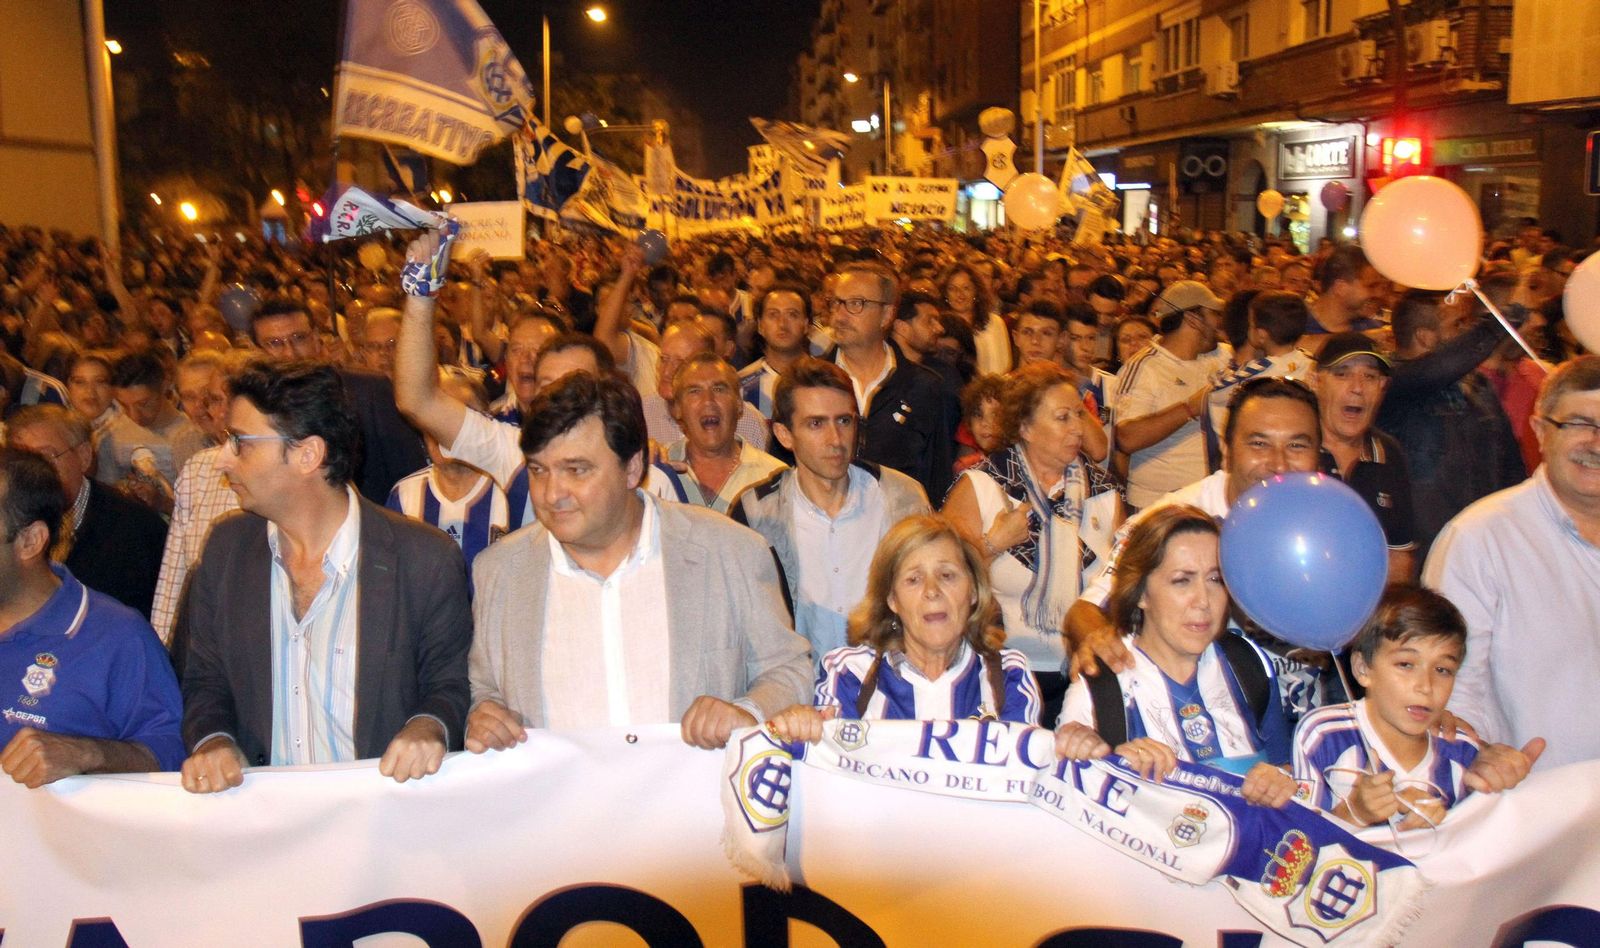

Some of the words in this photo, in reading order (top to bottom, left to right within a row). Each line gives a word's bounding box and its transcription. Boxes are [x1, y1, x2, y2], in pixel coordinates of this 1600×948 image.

[838, 755, 930, 786] DECANO
[945, 773, 989, 793] DEL
[1079, 808, 1183, 872] NACIONAL
